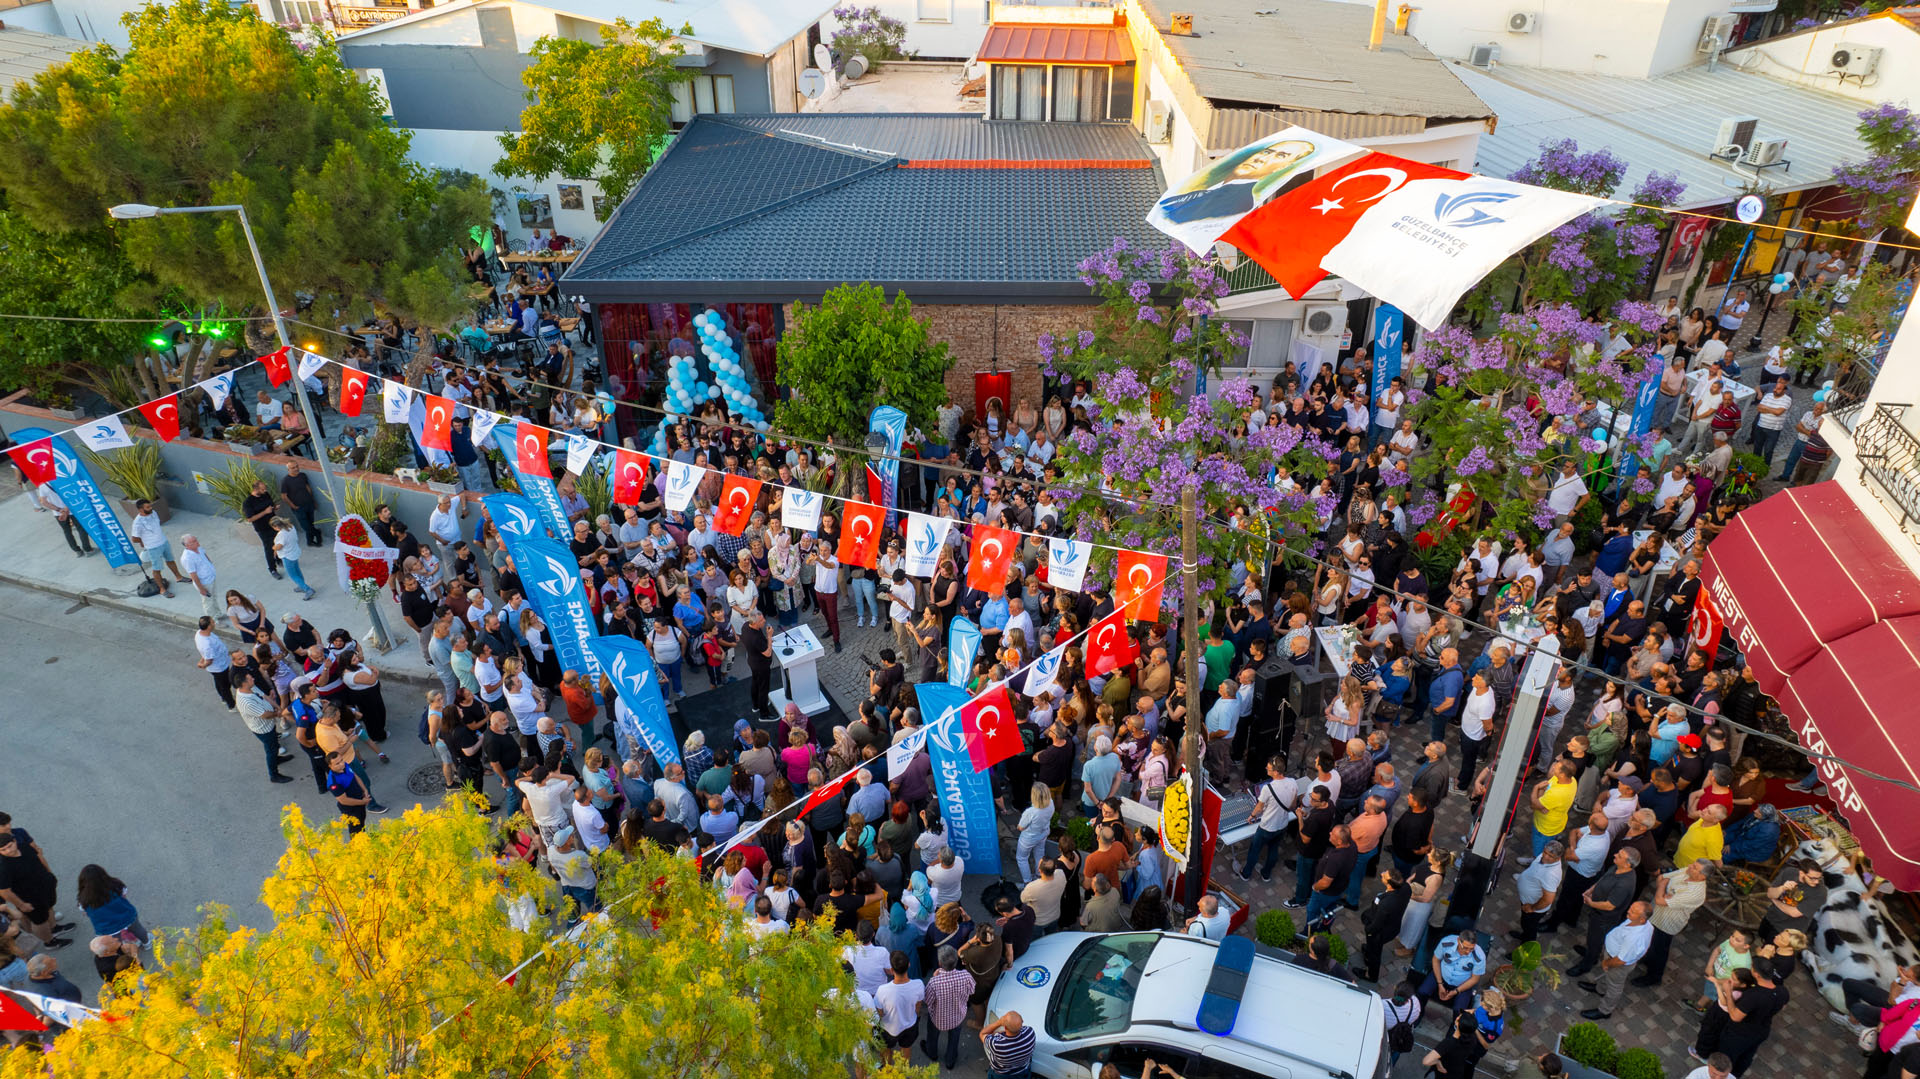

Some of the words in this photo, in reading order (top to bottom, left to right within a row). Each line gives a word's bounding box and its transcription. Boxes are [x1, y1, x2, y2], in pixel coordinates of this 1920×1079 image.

[1392, 221, 1461, 258] BELEDİYESİ
[1401, 215, 1469, 250] GÜZELBAHÇE
[1712, 575, 1743, 626] MEST
[1740, 624, 1758, 653] ET
[1801, 719, 1862, 813] KASAP
[941, 760, 972, 861] GÜZELBAHÇE
[959, 758, 995, 864] BELEDİYESİ
